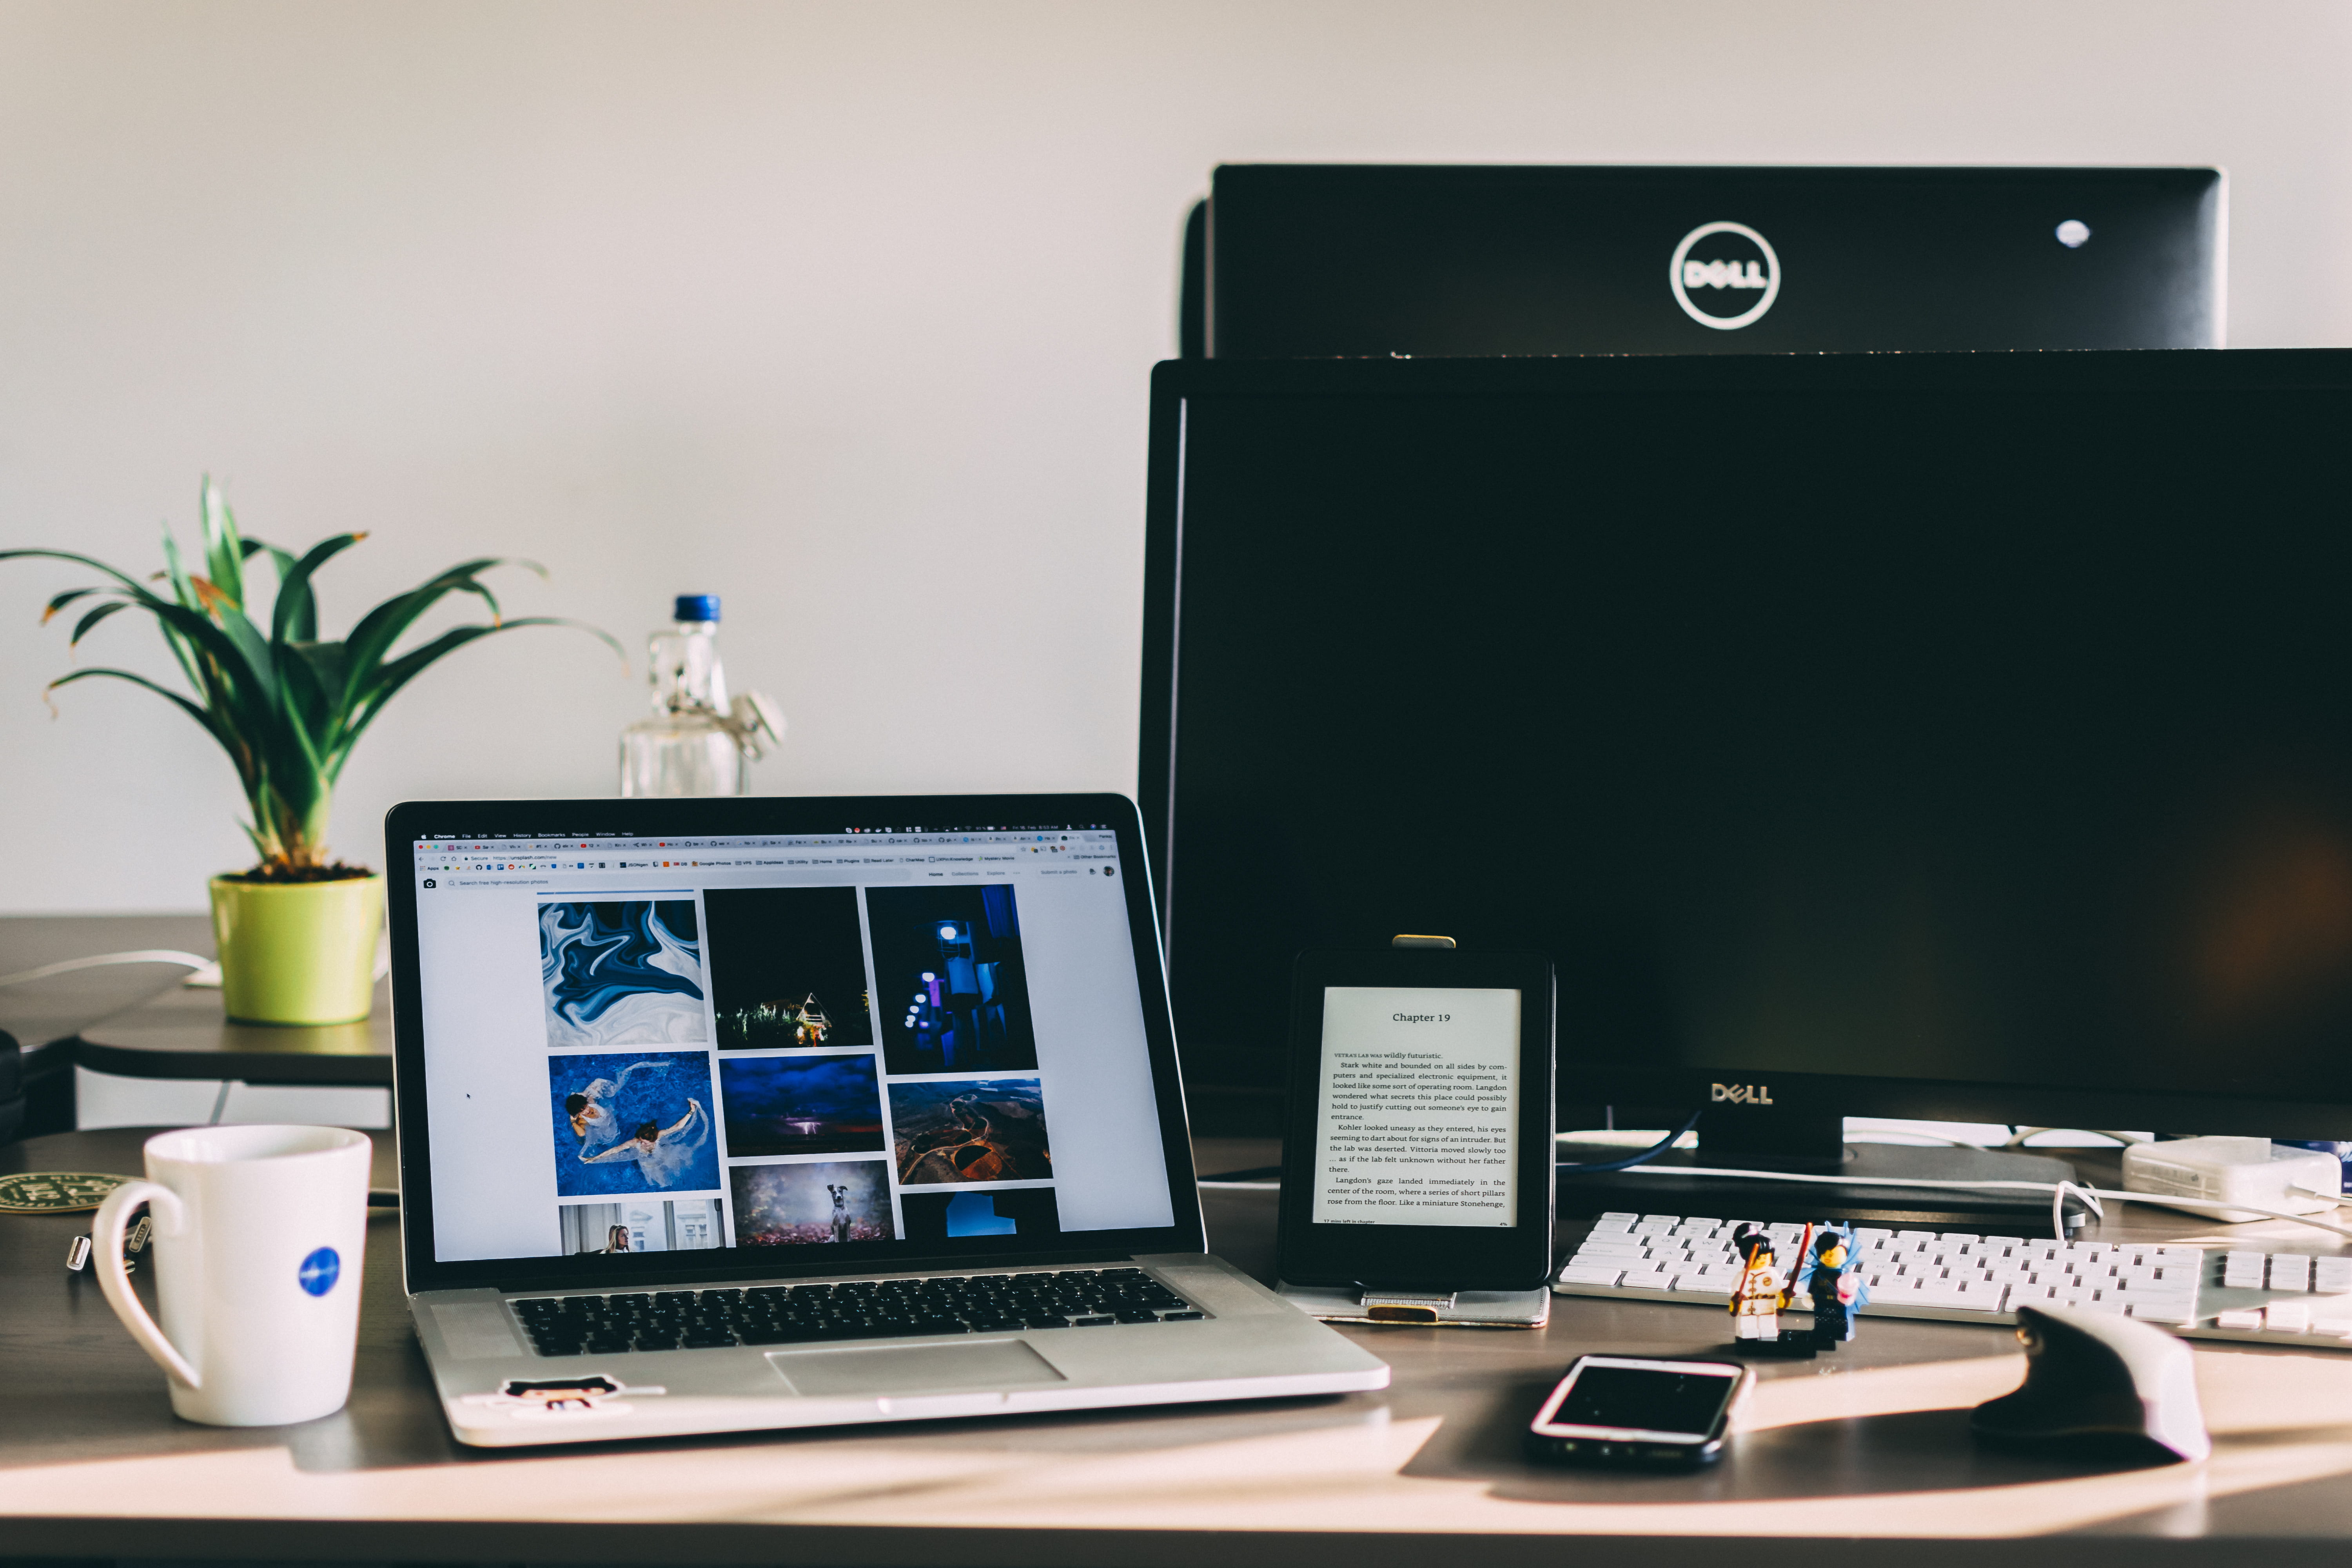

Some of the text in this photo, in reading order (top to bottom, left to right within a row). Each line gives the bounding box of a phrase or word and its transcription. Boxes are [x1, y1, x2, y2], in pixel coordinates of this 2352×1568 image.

[1684, 259, 1767, 289] DELL
[1392, 1013, 1436, 1024] Chapter
[1711, 1083, 1773, 1104] DELL
[1429, 1178, 1475, 1187] immediately
[1460, 1200, 1505, 1209] Stonehenge,
